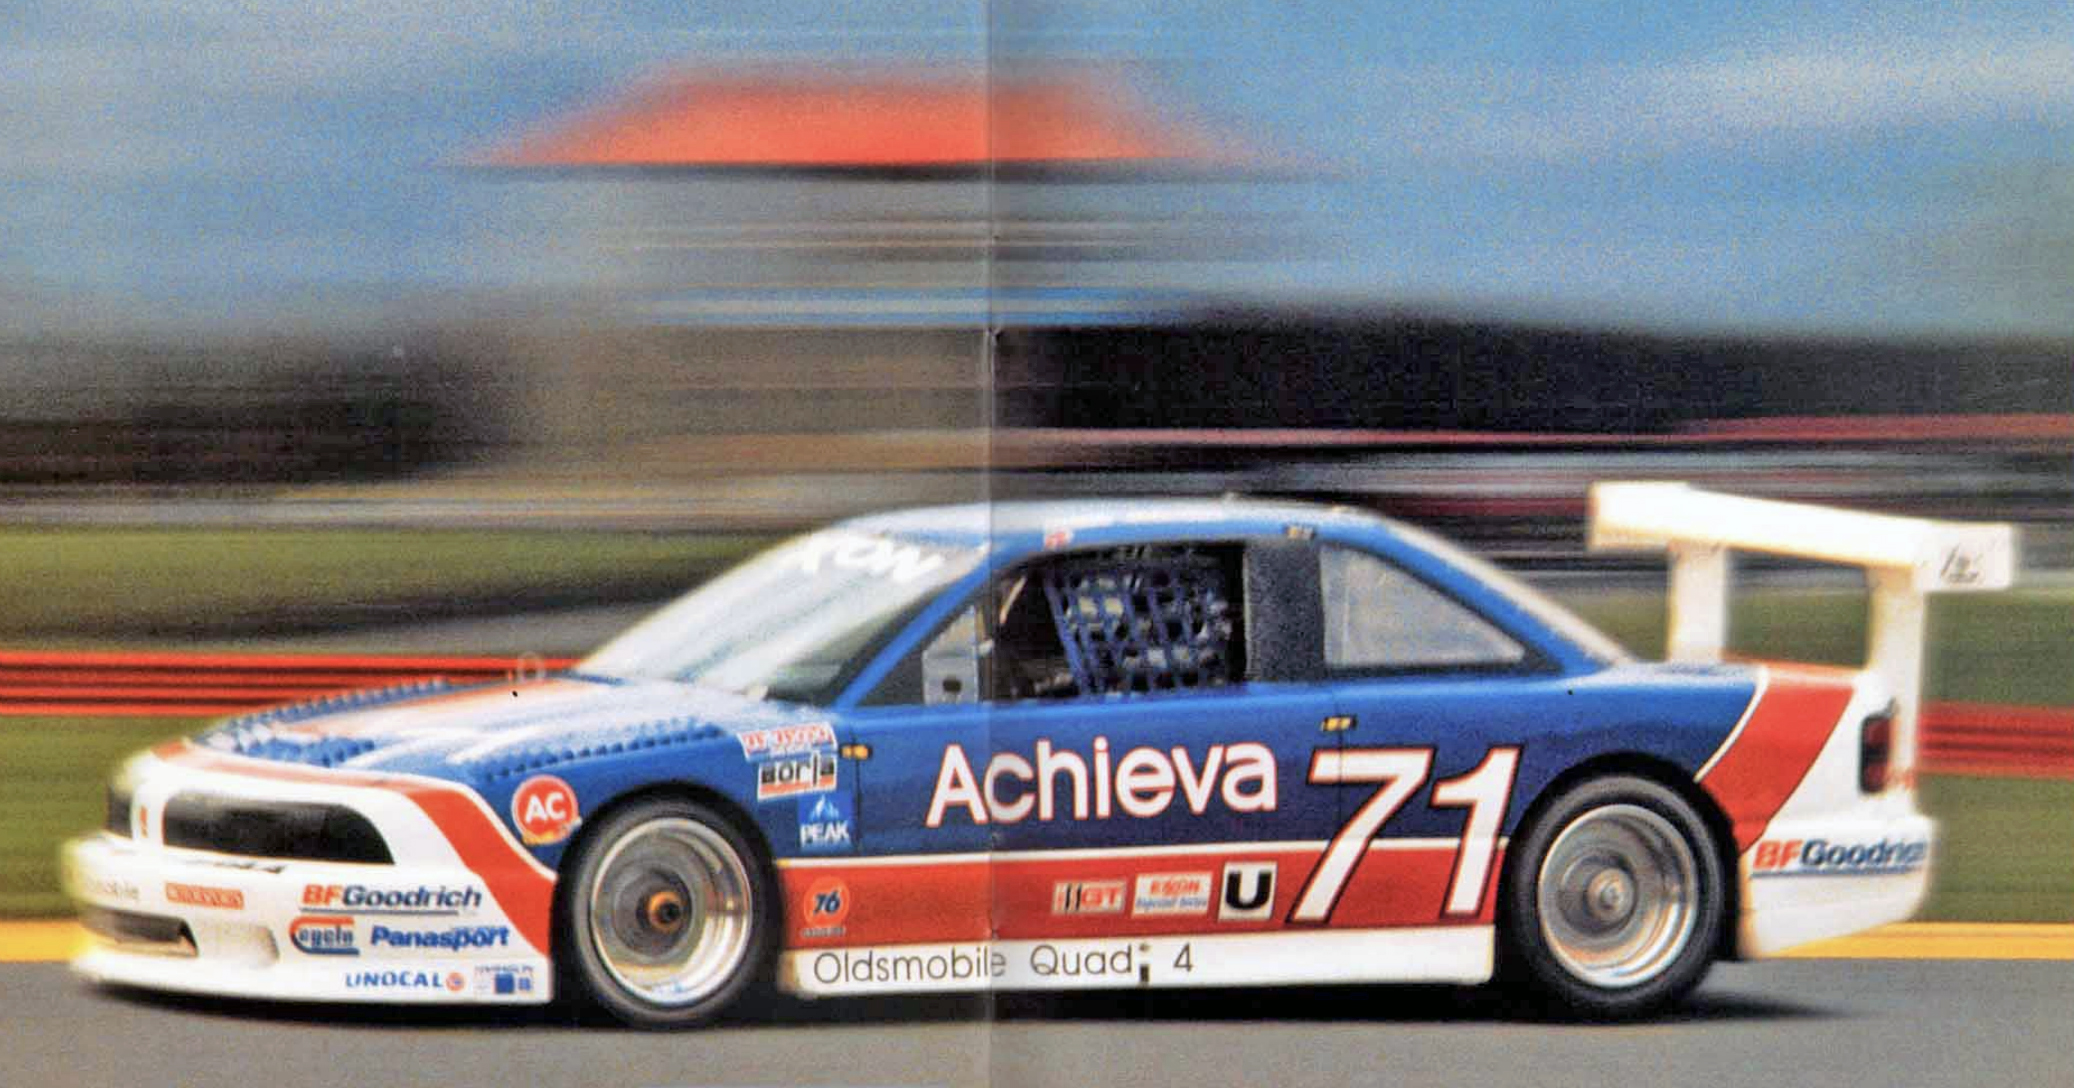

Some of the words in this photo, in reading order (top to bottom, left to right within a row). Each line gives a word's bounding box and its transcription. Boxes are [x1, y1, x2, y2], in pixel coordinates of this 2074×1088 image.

[926, 738, 1276, 828] Achieva
[525, 792, 566, 824] AC
[801, 820, 849, 847] PEAK
[1287, 746, 1521, 927] 71
[302, 884, 482, 909] BFGoodrich
[813, 889, 841, 915] 76
[1226, 870, 1273, 911] U
[371, 924, 509, 950] Panasport
[814, 945, 1006, 985] Oldsmobile
[1030, 943, 1134, 976] Quad
[1173, 941, 1195, 975] 4
[345, 971, 444, 989] UNOCAL
